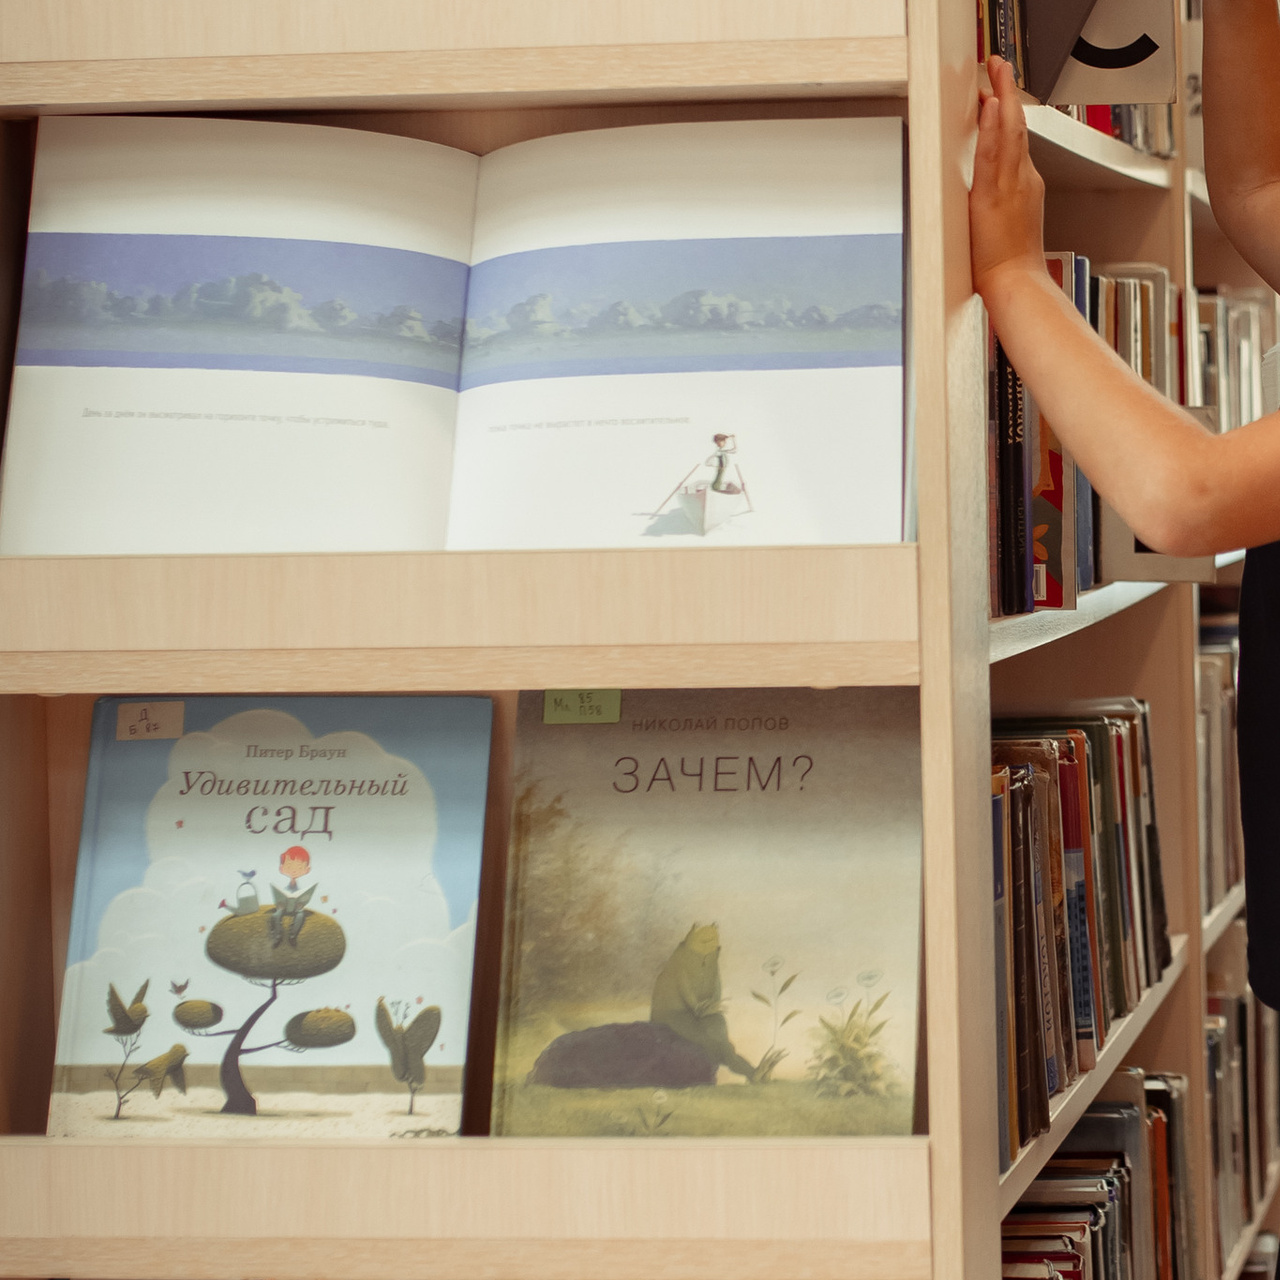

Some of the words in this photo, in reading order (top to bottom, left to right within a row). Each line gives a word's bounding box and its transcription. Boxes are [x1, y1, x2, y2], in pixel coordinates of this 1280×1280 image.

[631, 716, 718, 732] НИКОЛАЙ
[723, 717, 790, 732] ПОПОВ
[245, 744, 294, 760] Питер
[298, 744, 347, 760] Браун
[178, 771, 409, 796] Удивительный
[612, 755, 814, 794] ЗАЧЕМ?
[245, 804, 336, 841] сад
